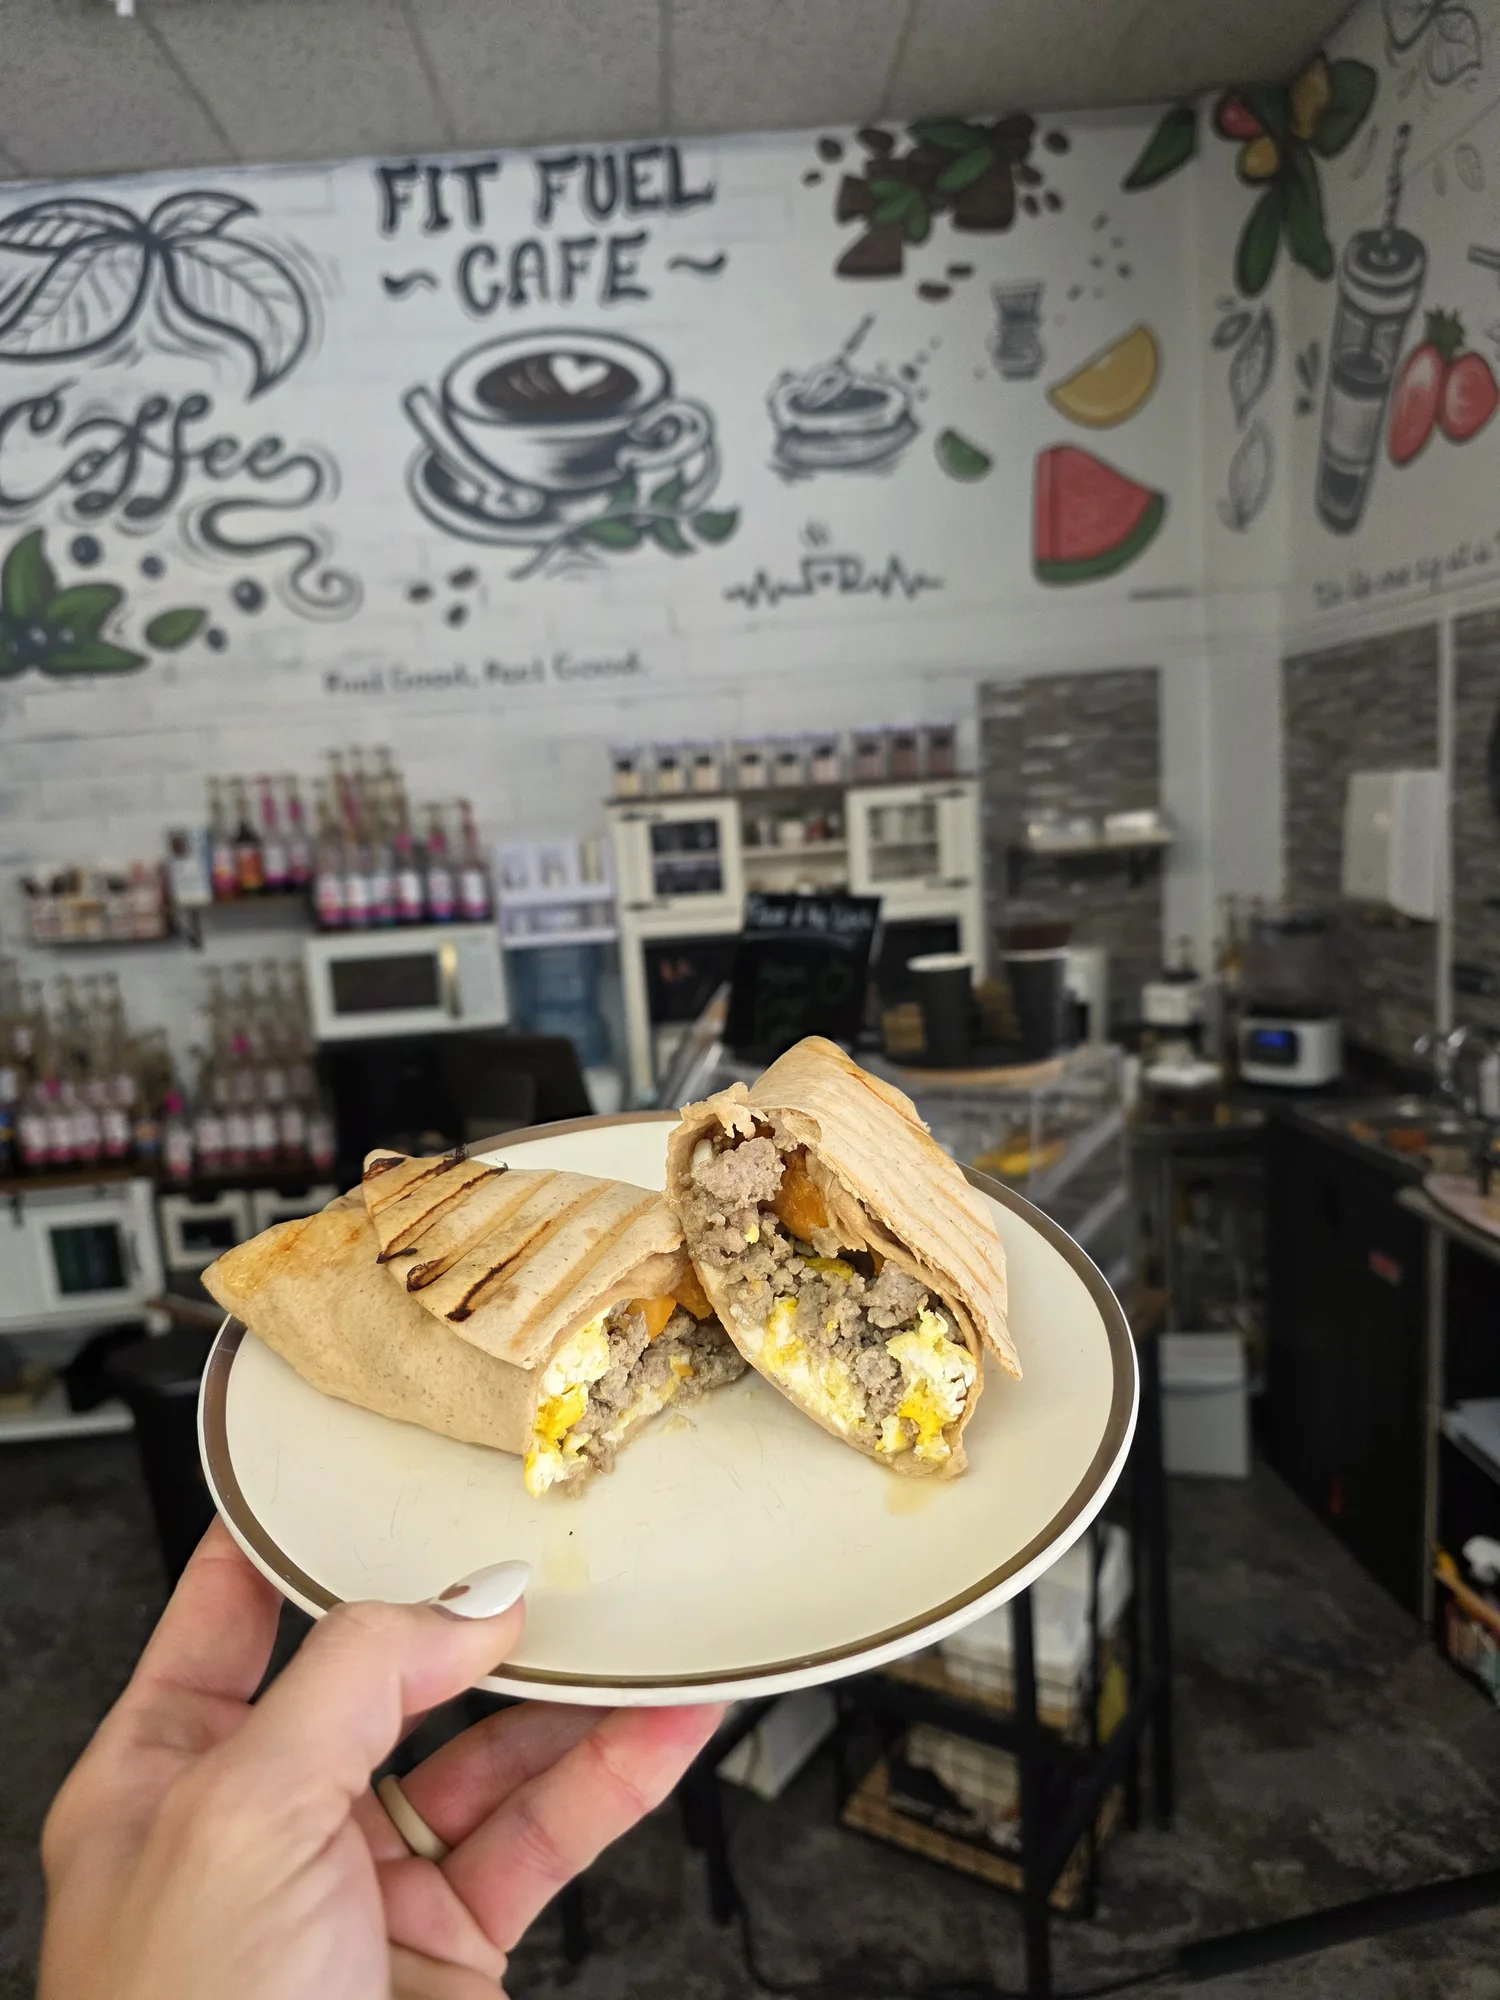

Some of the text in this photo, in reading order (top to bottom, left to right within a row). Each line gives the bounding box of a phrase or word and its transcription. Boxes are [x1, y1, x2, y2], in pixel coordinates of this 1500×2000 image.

[376, 144, 714, 234] FIT FUEL
[459, 231, 649, 315] CAFE
[0, 378, 325, 525] Coffee
